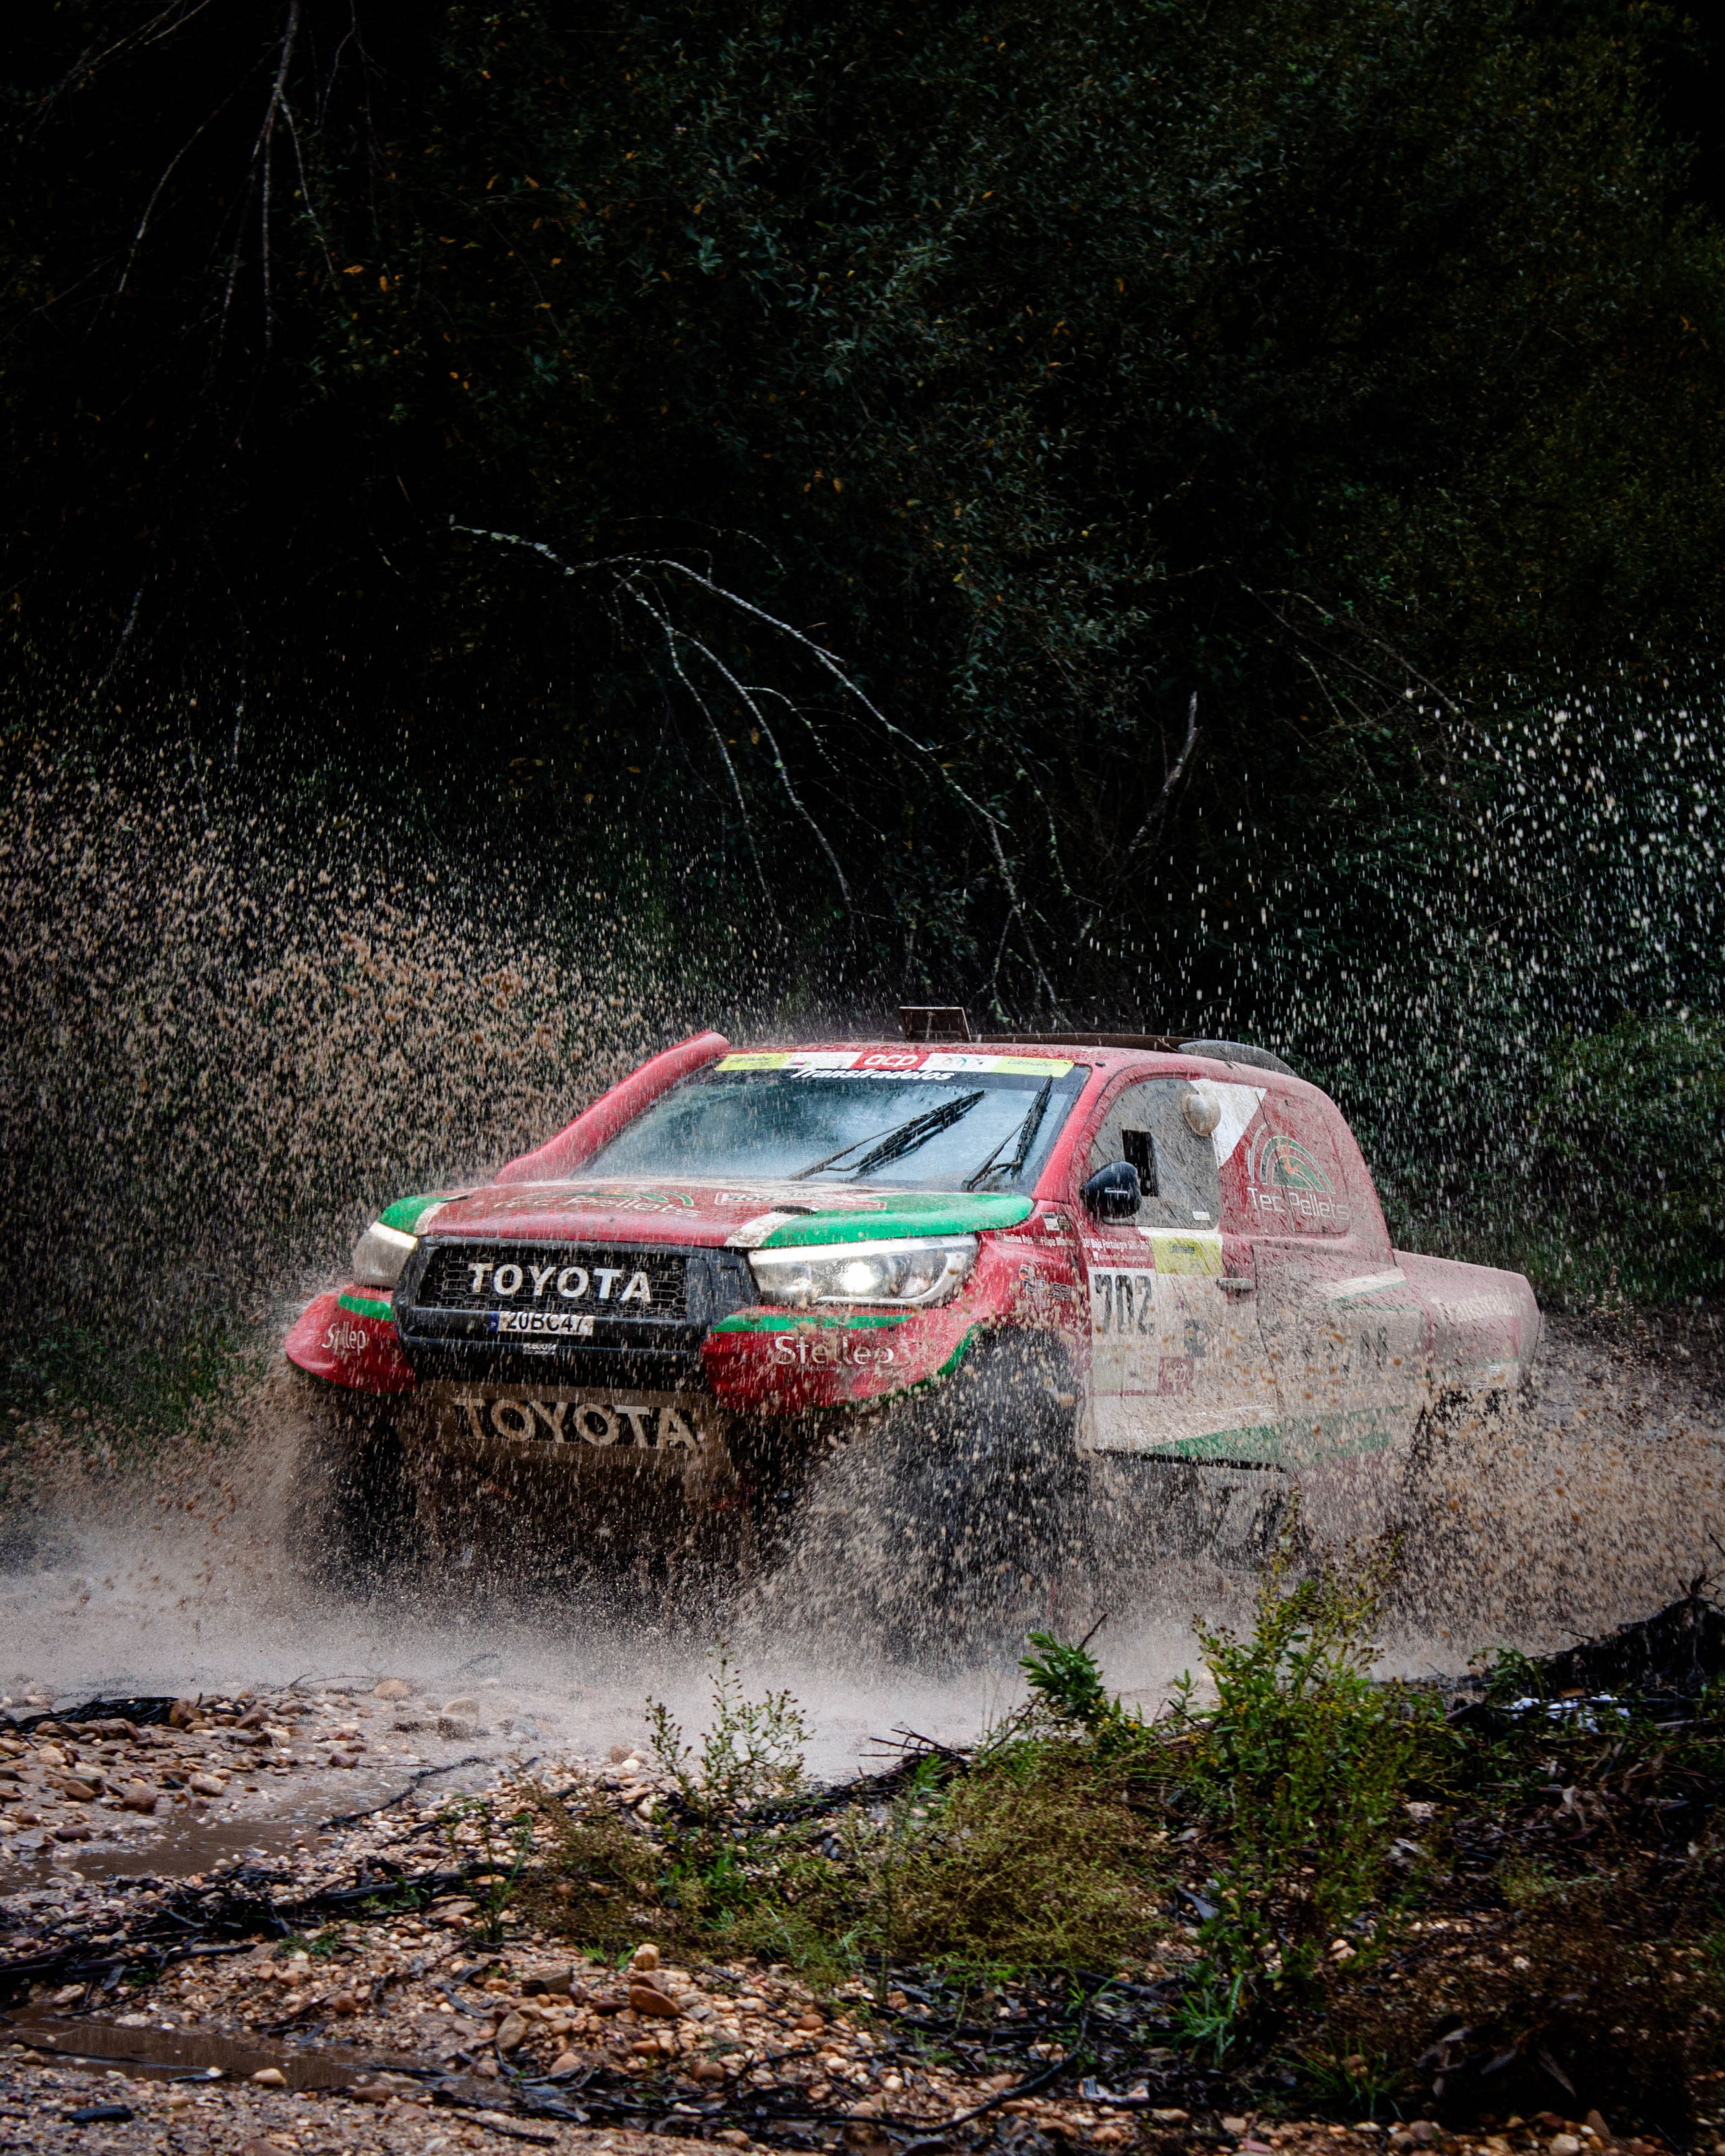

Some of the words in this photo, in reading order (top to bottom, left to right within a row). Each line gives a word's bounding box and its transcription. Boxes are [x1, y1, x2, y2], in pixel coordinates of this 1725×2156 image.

[791, 1068, 955, 1081] Transfradelos
[863, 1054, 918, 1067] acp
[1247, 1187, 1284, 1212] Tec
[1288, 1192, 1349, 1221] Pellets
[468, 1263, 652, 1303] TOYOTA
[1094, 1274, 1155, 1335] 702
[452, 1397, 699, 1451] TOYOTA
